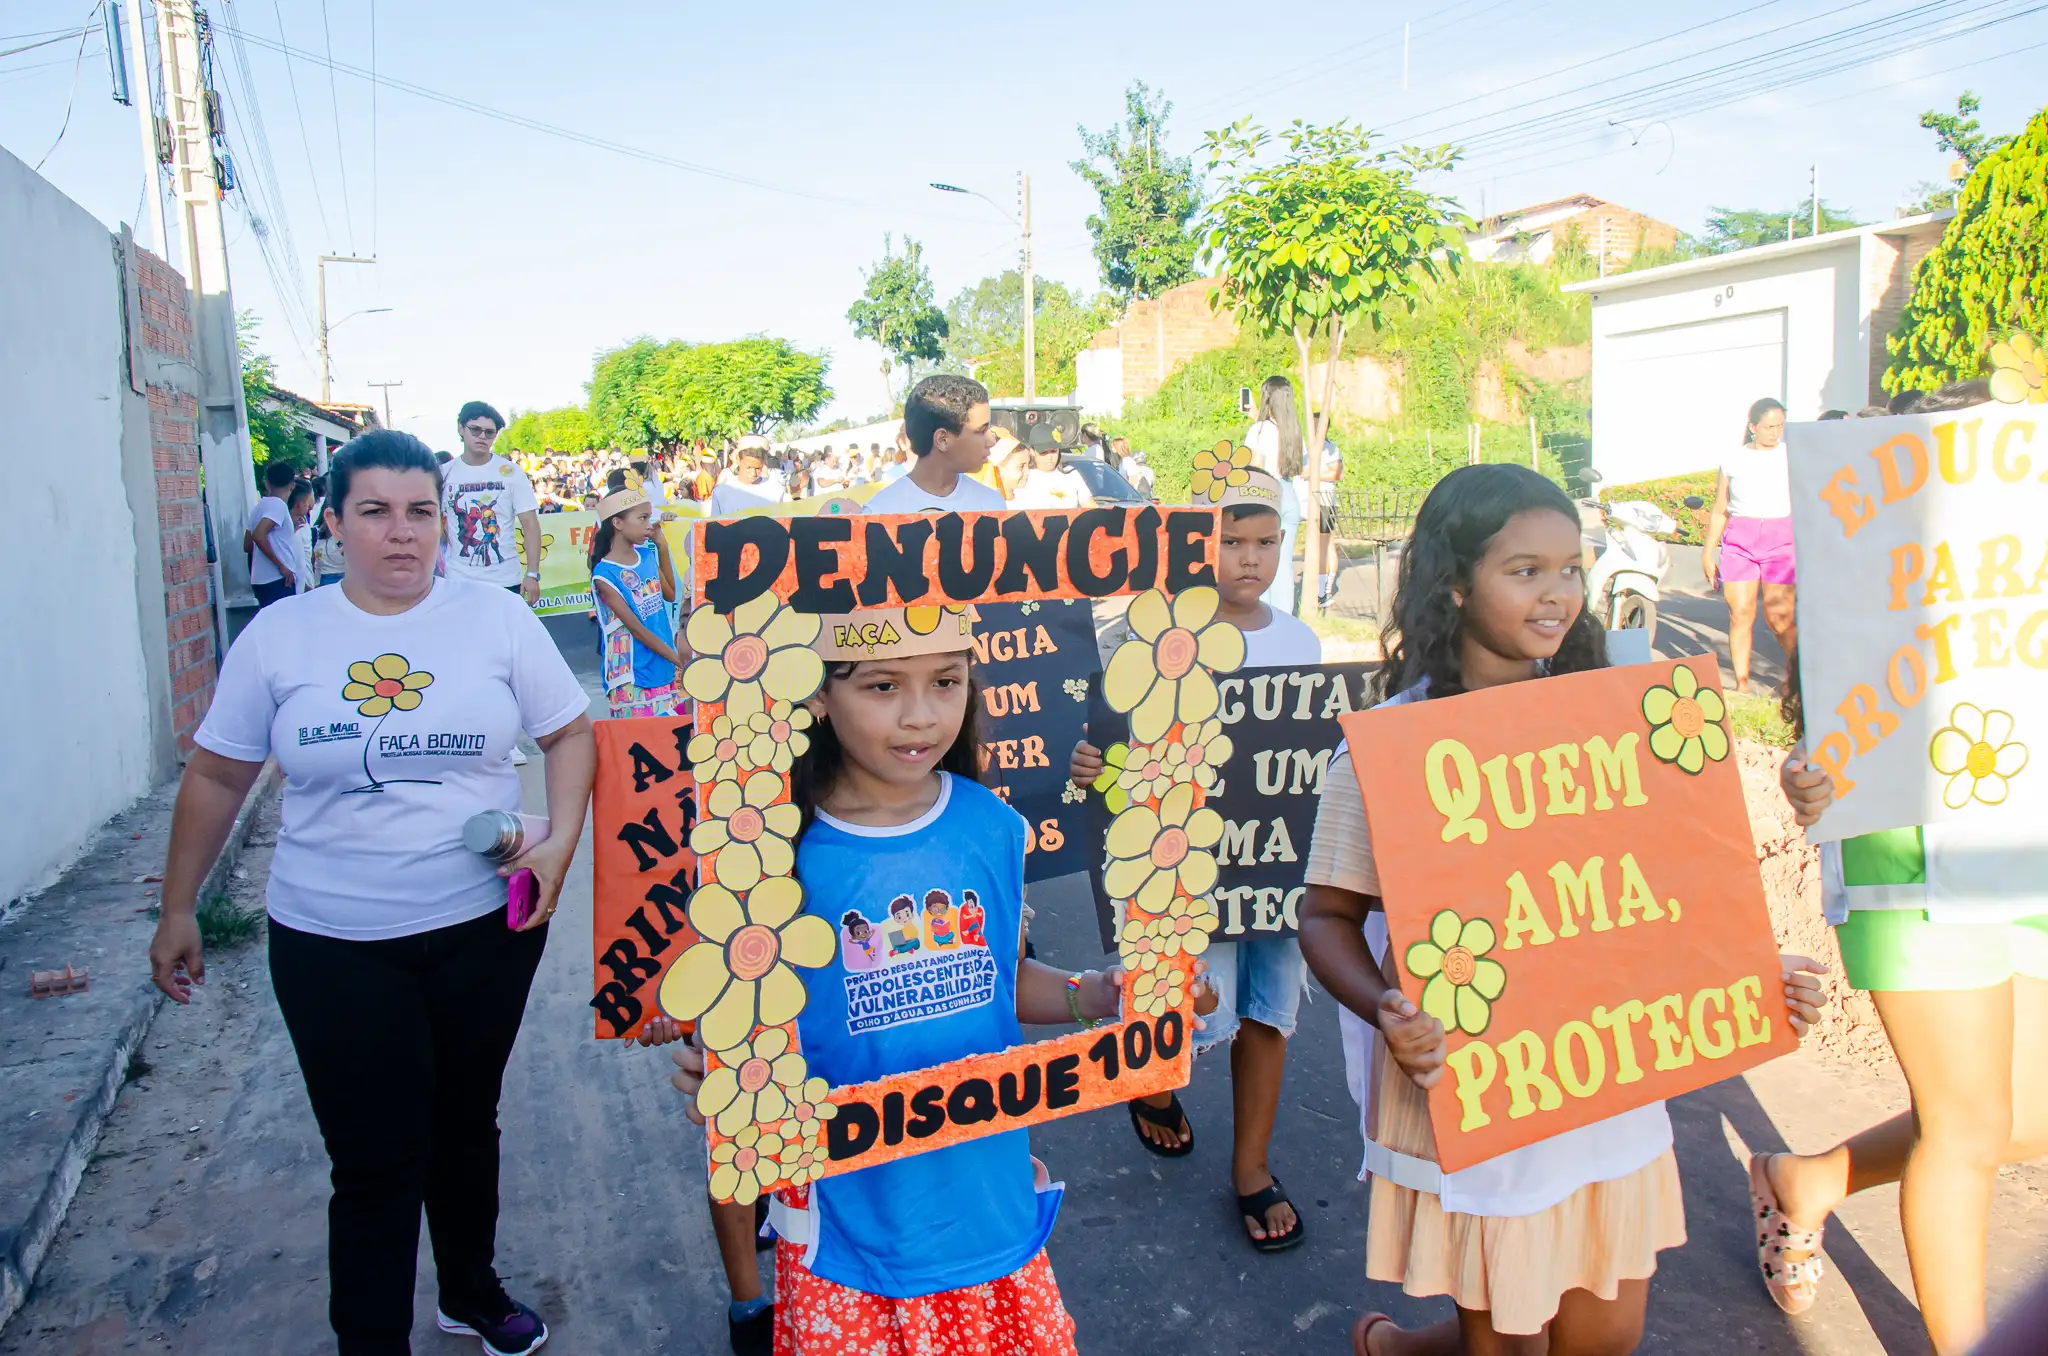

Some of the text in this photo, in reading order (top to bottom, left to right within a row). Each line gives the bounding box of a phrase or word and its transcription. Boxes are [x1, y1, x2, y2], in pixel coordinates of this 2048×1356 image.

[1714, 285, 1734, 307] 90
[1818, 418, 2048, 539] EDUC
[704, 505, 1219, 614] DENUNCIE
[834, 619, 902, 654] FAÇA
[982, 681, 1041, 717] UM
[298, 727, 308, 738] 18
[312, 725, 326, 736] DE
[380, 735, 420, 751] FAÇA
[427, 733, 486, 749] BONITO
[628, 741, 674, 793] A
[1424, 732, 1649, 845] QUEM
[1503, 852, 1682, 950] AMA,
[590, 867, 698, 1037] BRIN
[846, 968, 889, 987] PROJETO
[890, 953, 955, 976] RESGATANDO
[856, 1016, 881, 1029] OLHO
[883, 1008, 924, 1025] D'ÁGUA
[927, 1001, 948, 1016] DAS
[1446, 975, 1772, 1132] PROTEGE
[827, 1011, 1184, 1161] DISQUE 100
